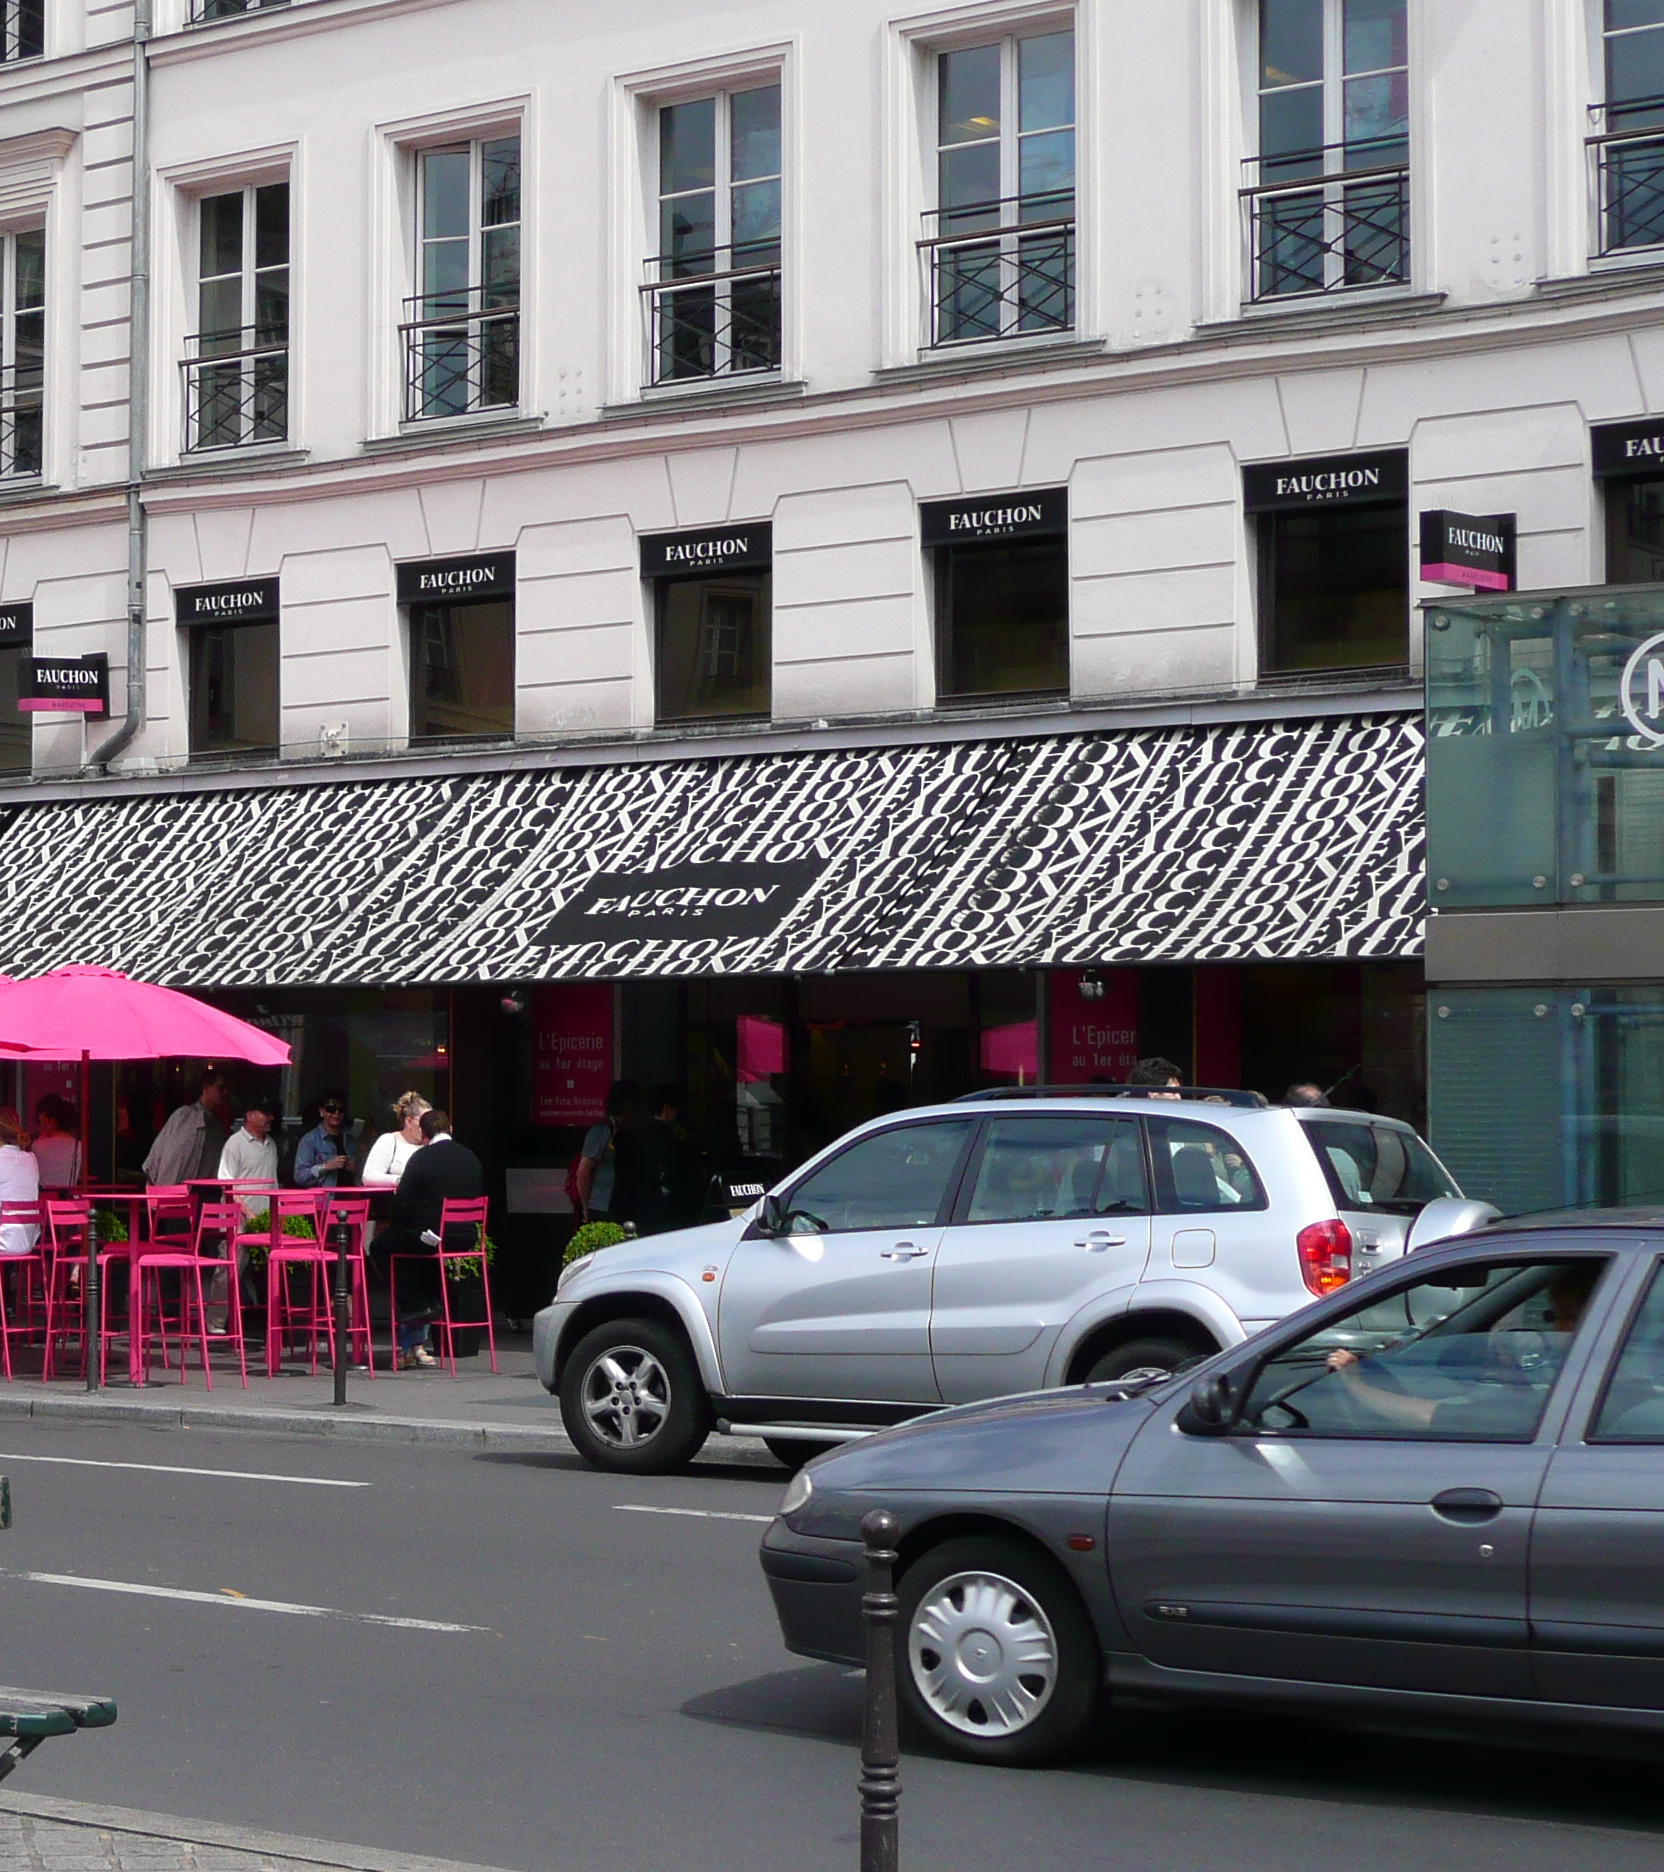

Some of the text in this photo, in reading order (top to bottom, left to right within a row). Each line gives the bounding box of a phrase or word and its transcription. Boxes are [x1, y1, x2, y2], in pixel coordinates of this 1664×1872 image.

[1276, 468, 1379, 494] FAUCHON
[1307, 490, 1348, 500] PARIS
[949, 505, 1041, 530] FAUCHON
[977, 526, 1014, 535] PARIS
[665, 538, 748, 560] FAUCHON
[1448, 527, 1504, 554] FAUCHON
[689, 558, 723, 566] PARIS
[420, 566, 495, 588] FAUCHON
[441, 585, 472, 593] PARIS
[195, 591, 263, 611] FAUCHON
[37, 669, 98, 684] FAUCHON
[584, 885, 781, 915] FAUCHON
[627, 907, 705, 918] PARIS
[539, 1031, 603, 1054] L'Epicerie
[539, 1057, 604, 1072] au 1er étage
[1072, 1056, 1086, 1066] au
[1093, 1053, 1111, 1066] 1er
